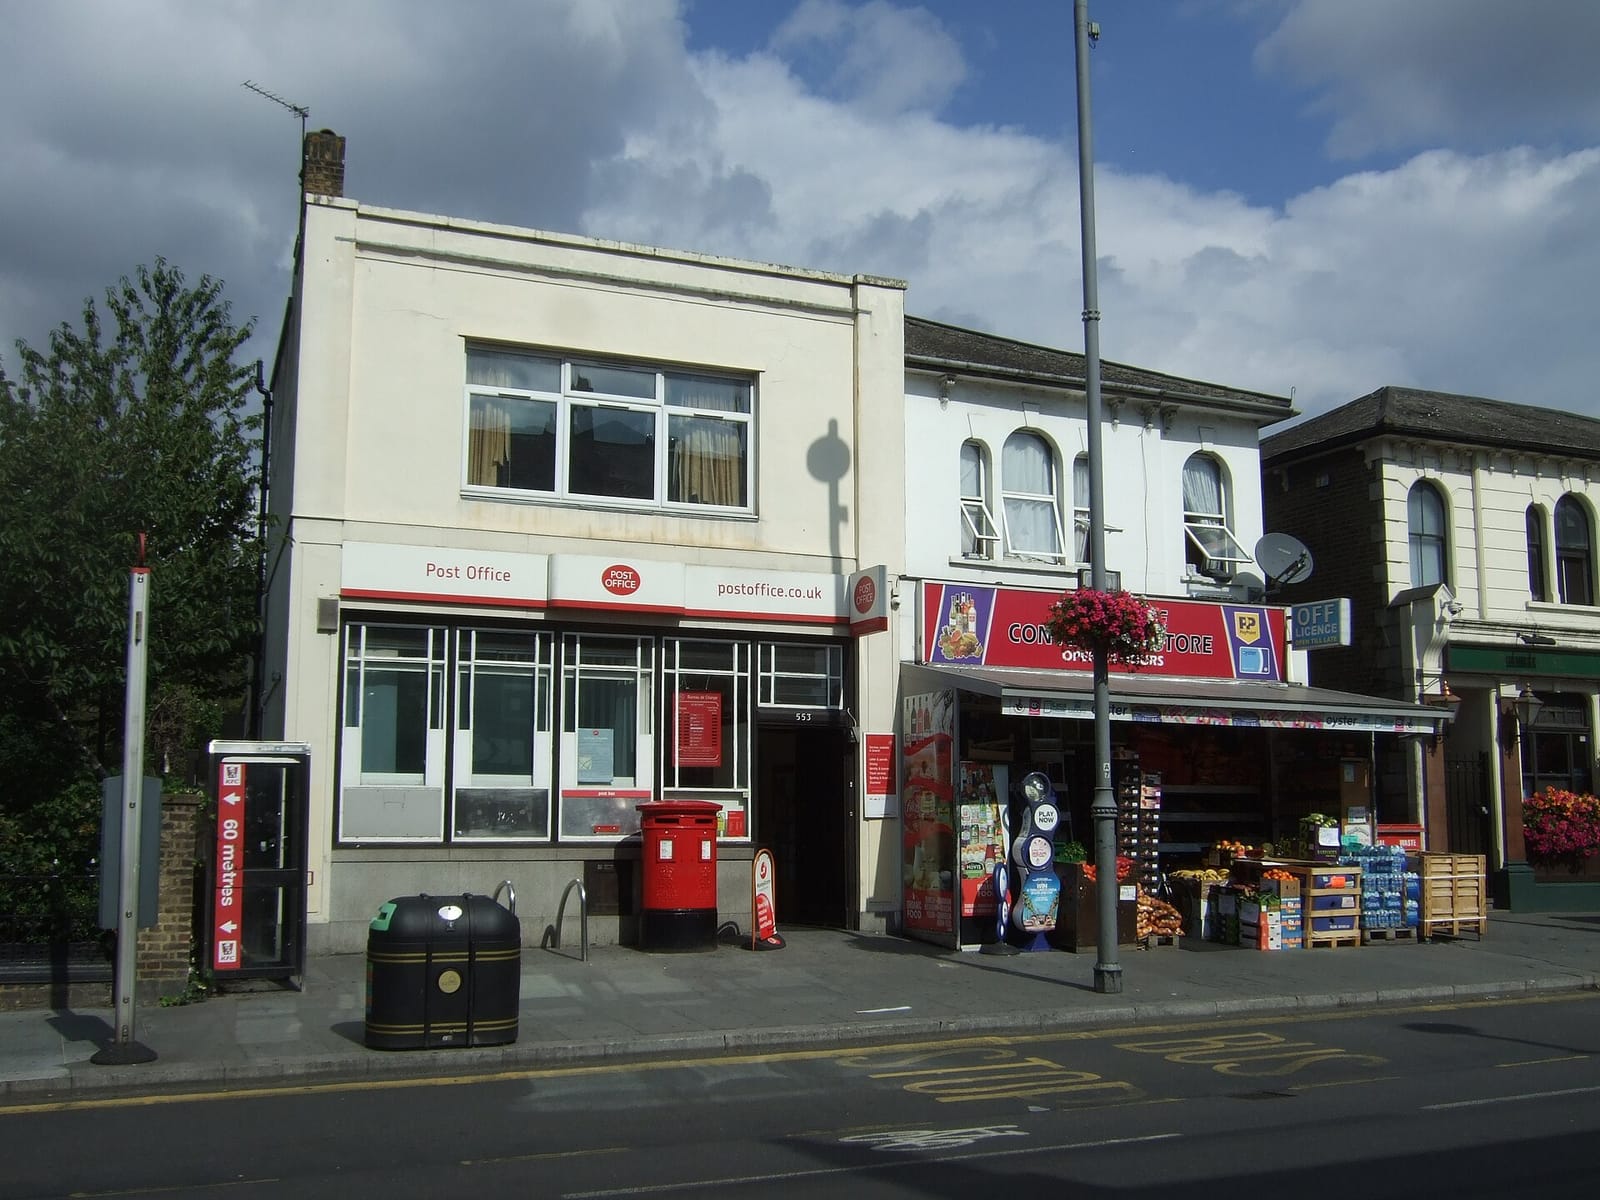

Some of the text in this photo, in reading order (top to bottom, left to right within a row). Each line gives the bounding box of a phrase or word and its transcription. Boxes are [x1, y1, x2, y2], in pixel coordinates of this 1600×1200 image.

[426, 562, 512, 582] Post Office
[610, 570, 633, 580] POST
[604, 578, 637, 590] OFFICE
[717, 582, 823, 600] postoffice.co.uk
[858, 583, 873, 594] POST
[856, 592, 874, 605] OFFICE
[1298, 604, 1334, 626] OFF
[1295, 623, 1338, 638] LICENCE
[1155, 632, 1214, 655] TORE
[795, 712, 812, 722] 553
[1326, 715, 1357, 727] oyster
[220, 820, 239, 907] 60 metres
